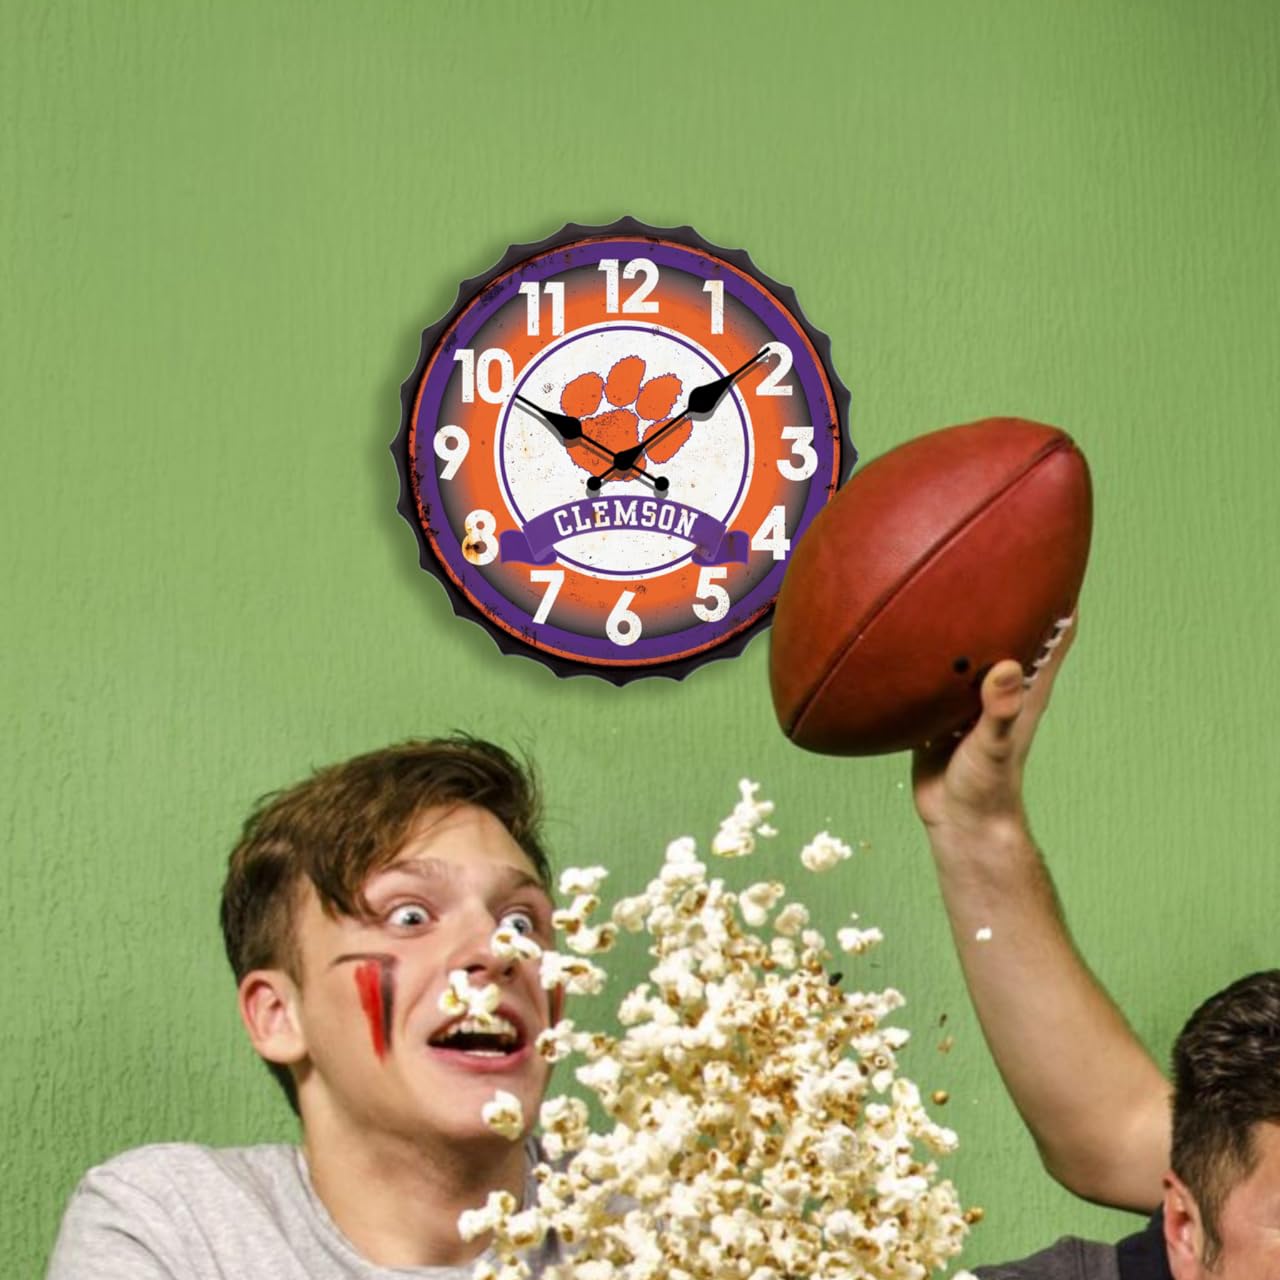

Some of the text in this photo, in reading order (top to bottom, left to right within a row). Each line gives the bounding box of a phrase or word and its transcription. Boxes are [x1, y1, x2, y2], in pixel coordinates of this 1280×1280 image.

[518, 281, 566, 336] 11
[598, 258, 660, 314] 12
[702, 280, 724, 335] 1
[453, 348, 514, 405] 10
[755, 341, 793, 396] 2
[433, 425, 470, 481] 9
[776, 426, 818, 481] 3
[461, 509, 499, 566] 8
[553, 500, 699, 538] CLEMSON
[750, 506, 791, 560] 4
[530, 570, 565, 624] 7
[605, 591, 642, 646] 6
[692, 567, 731, 623] 5
